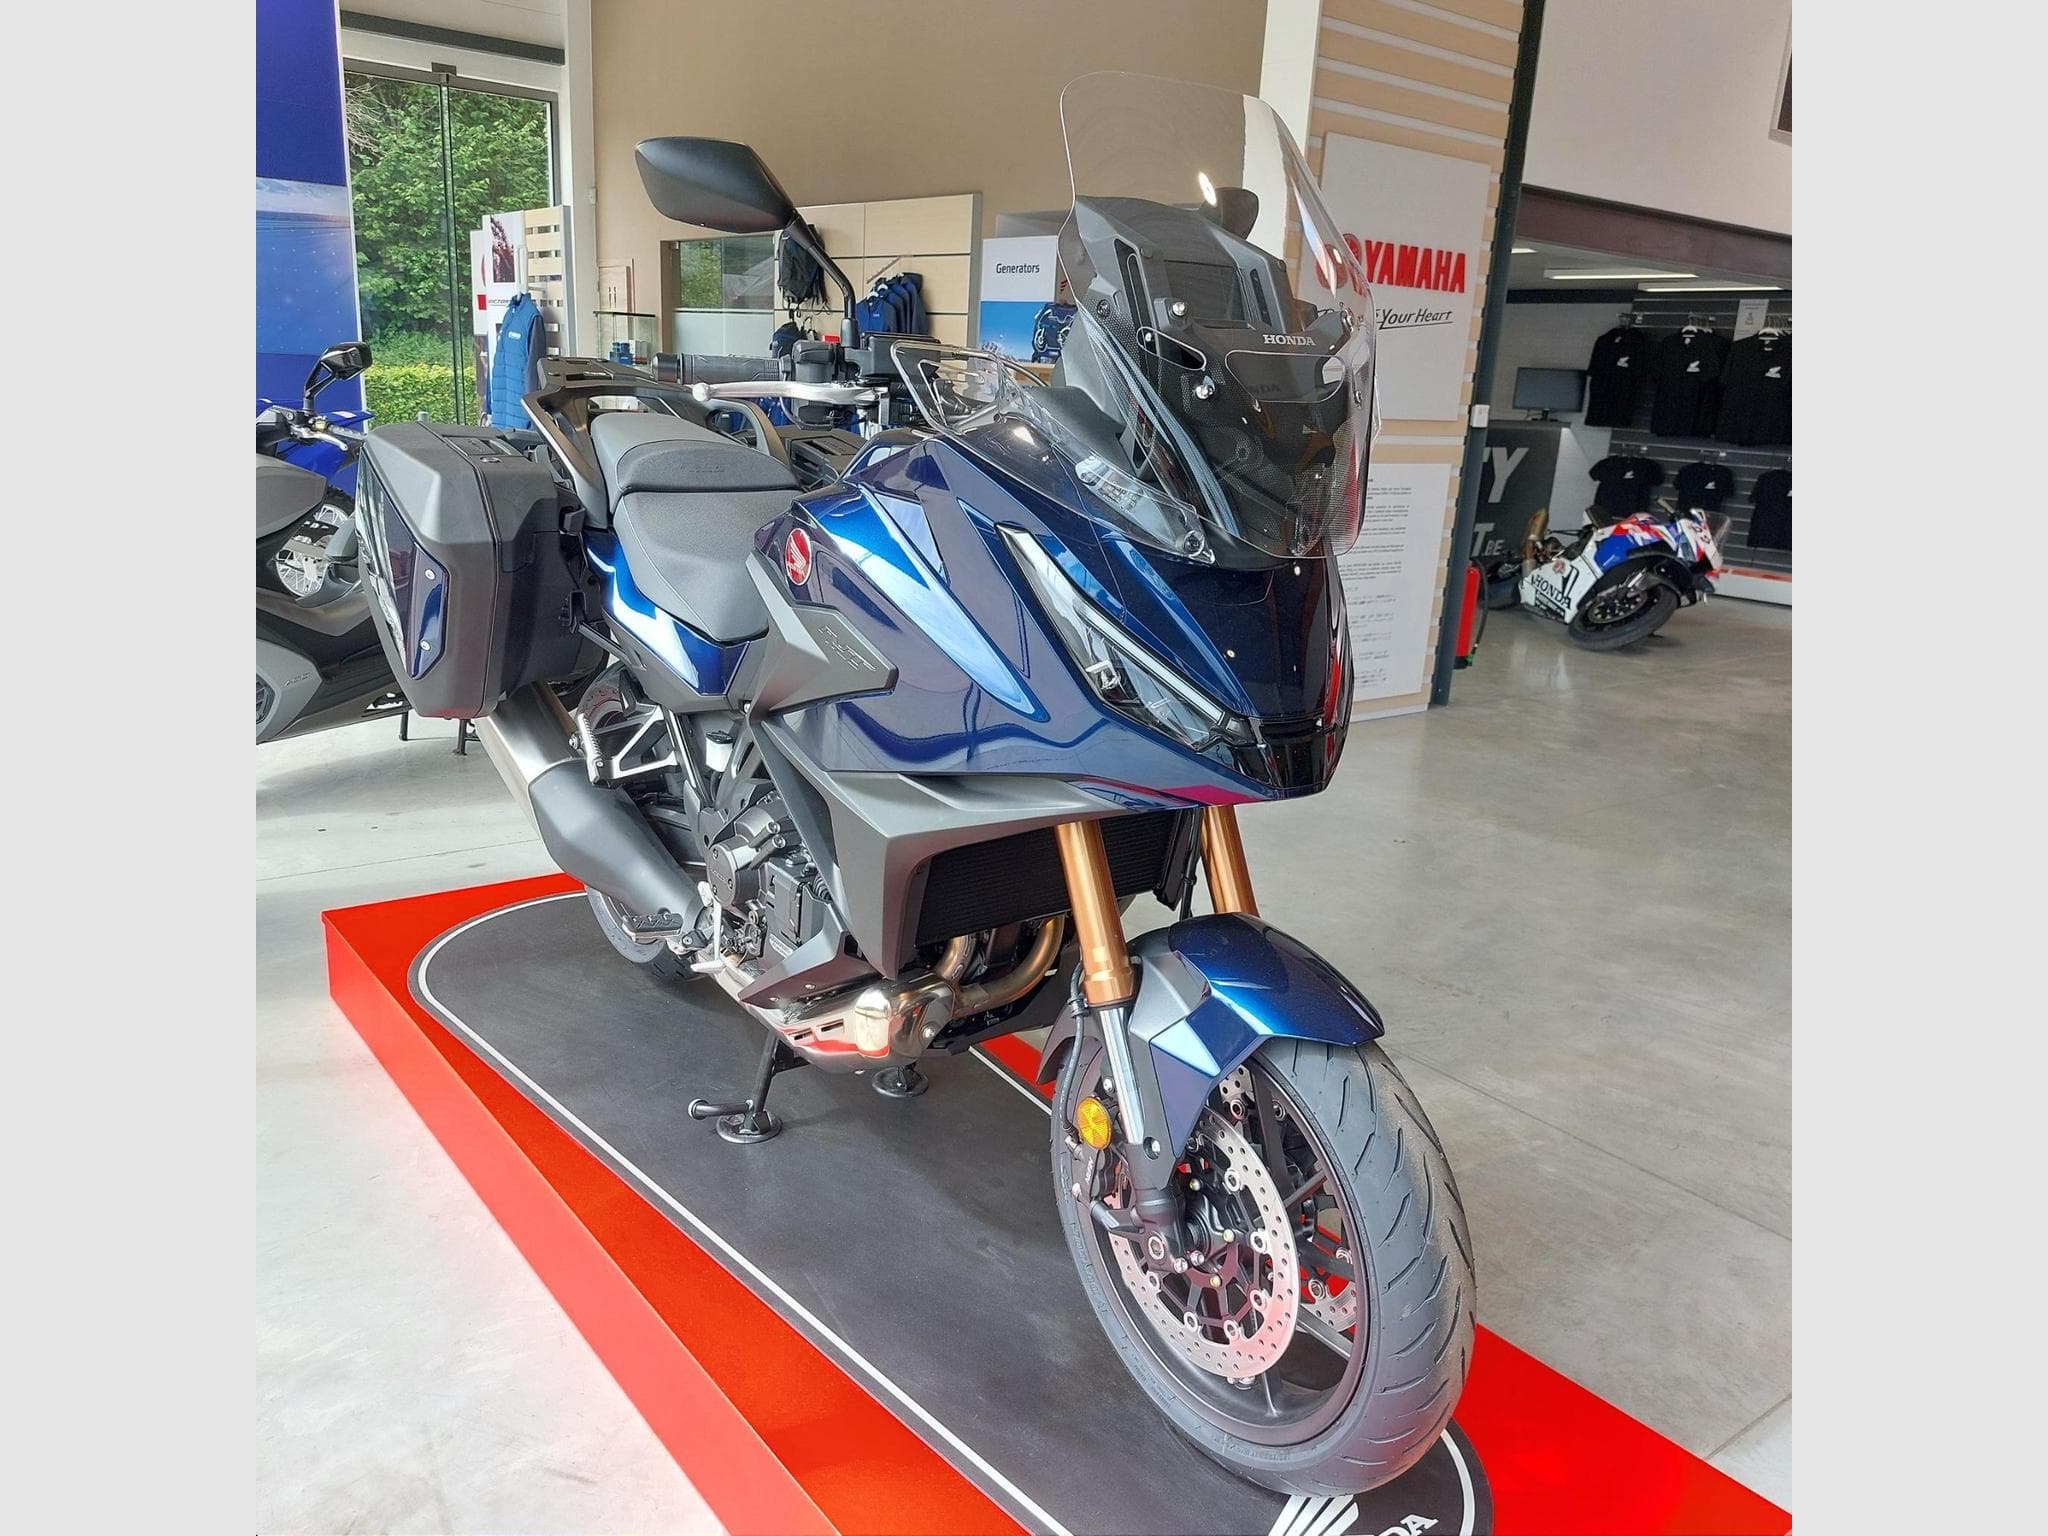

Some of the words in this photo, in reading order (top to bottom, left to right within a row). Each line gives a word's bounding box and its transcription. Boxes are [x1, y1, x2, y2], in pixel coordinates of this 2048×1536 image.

[996, 263, 1040, 274] Generators
[1365, 239, 1466, 293] YAMAHA
[1380, 308, 1416, 330] Your
[1415, 308, 1453, 324] Heart
[1262, 334, 1316, 346] HONDA
[1533, 573, 1572, 610] HONDA
